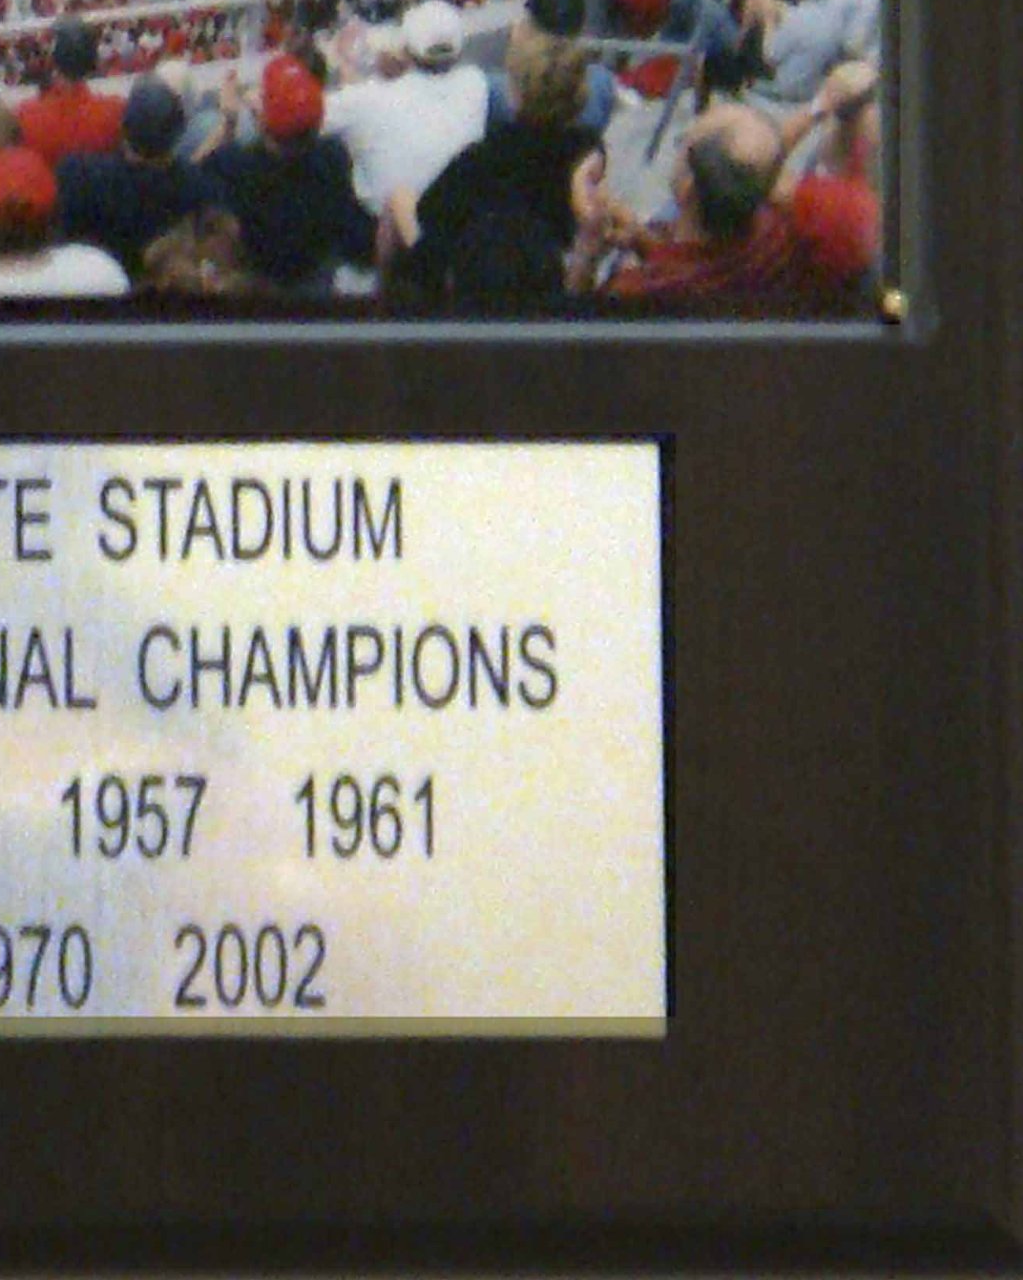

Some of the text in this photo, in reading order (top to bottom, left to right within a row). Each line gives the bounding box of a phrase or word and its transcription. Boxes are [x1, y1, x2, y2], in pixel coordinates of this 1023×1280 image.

[98, 476, 403, 563] STADIUM
[137, 623, 559, 712] CHAMPIONS
[61, 774, 208, 859] 1957
[295, 774, 434, 859] 1961
[174, 922, 326, 1009] 2002
